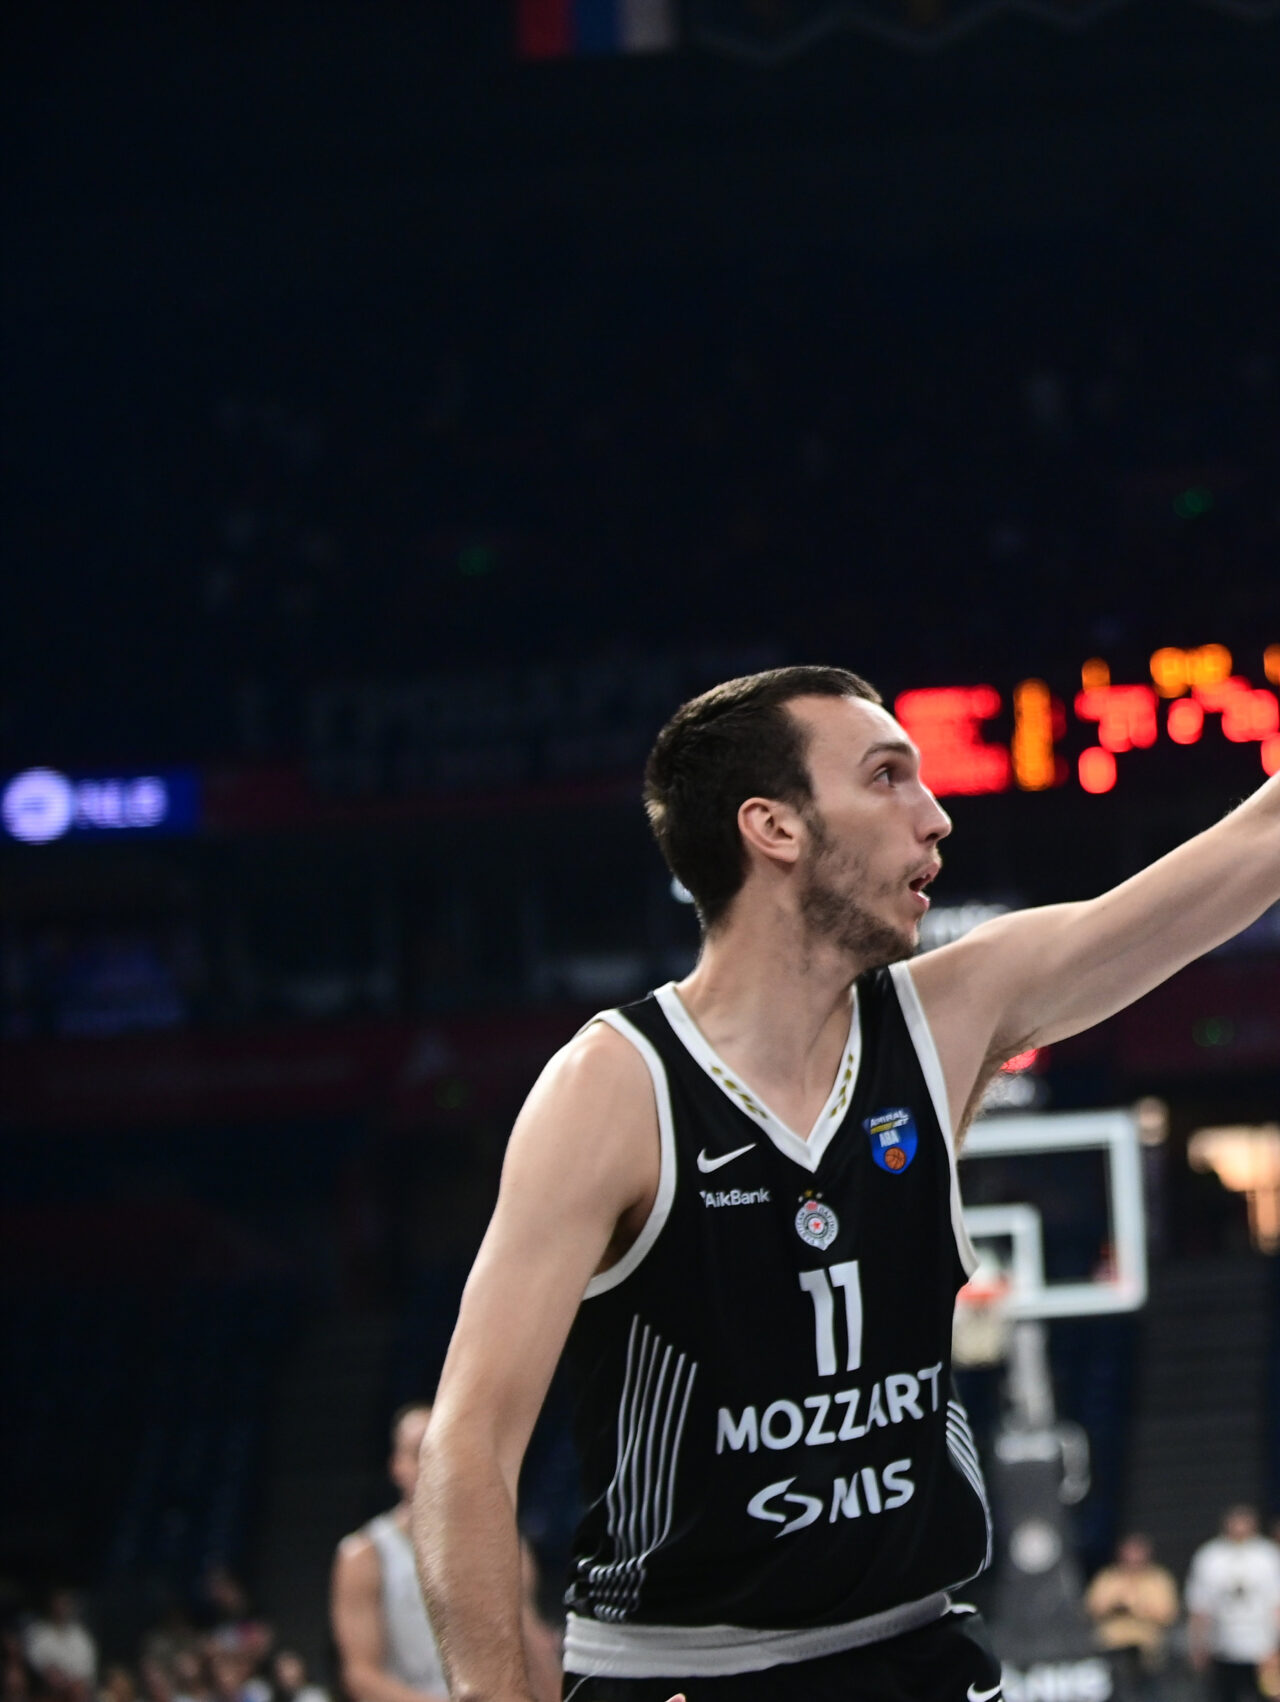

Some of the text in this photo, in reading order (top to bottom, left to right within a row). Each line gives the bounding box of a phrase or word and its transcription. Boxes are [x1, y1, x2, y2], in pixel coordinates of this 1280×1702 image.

[704, 1187, 770, 1208] AikBank
[799, 1260, 863, 1376] 11
[716, 1361, 943, 1455] MOZZART
[829, 1458, 915, 1523] NIS
